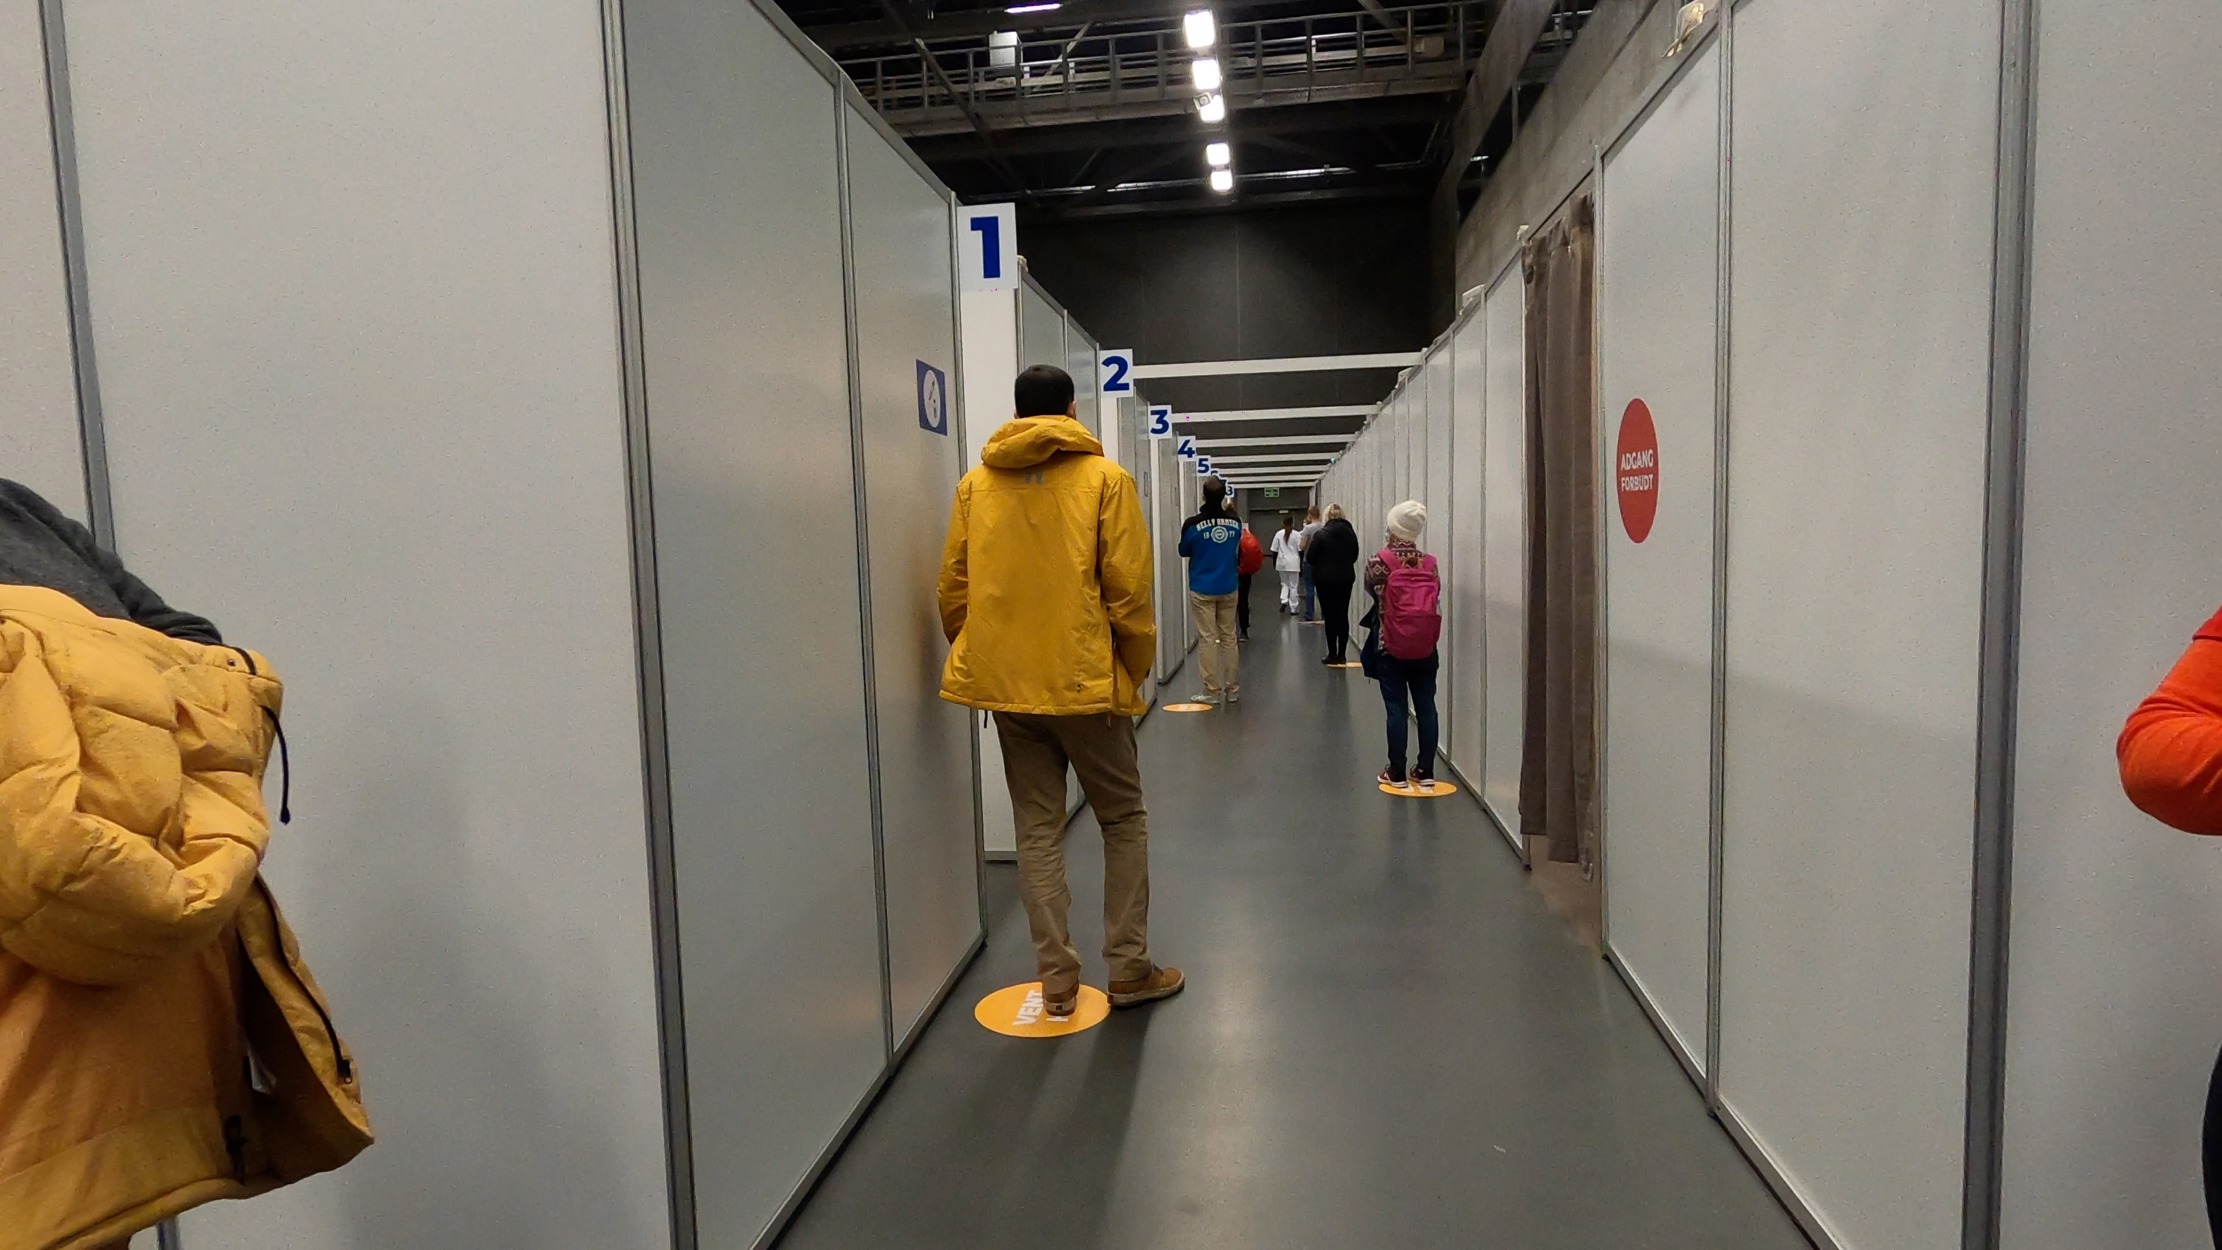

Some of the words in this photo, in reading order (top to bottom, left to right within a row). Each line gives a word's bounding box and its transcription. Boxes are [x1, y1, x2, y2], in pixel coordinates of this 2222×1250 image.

[970, 216, 1001, 279] 1
[1101, 355, 1130, 392] 2
[1150, 409, 1169, 434] 3
[1177, 439, 1195, 458] 4
[1197, 458, 1210, 473] 5
[1621, 449, 1654, 471] ADGANG
[1621, 474, 1654, 492] FORBUDT
